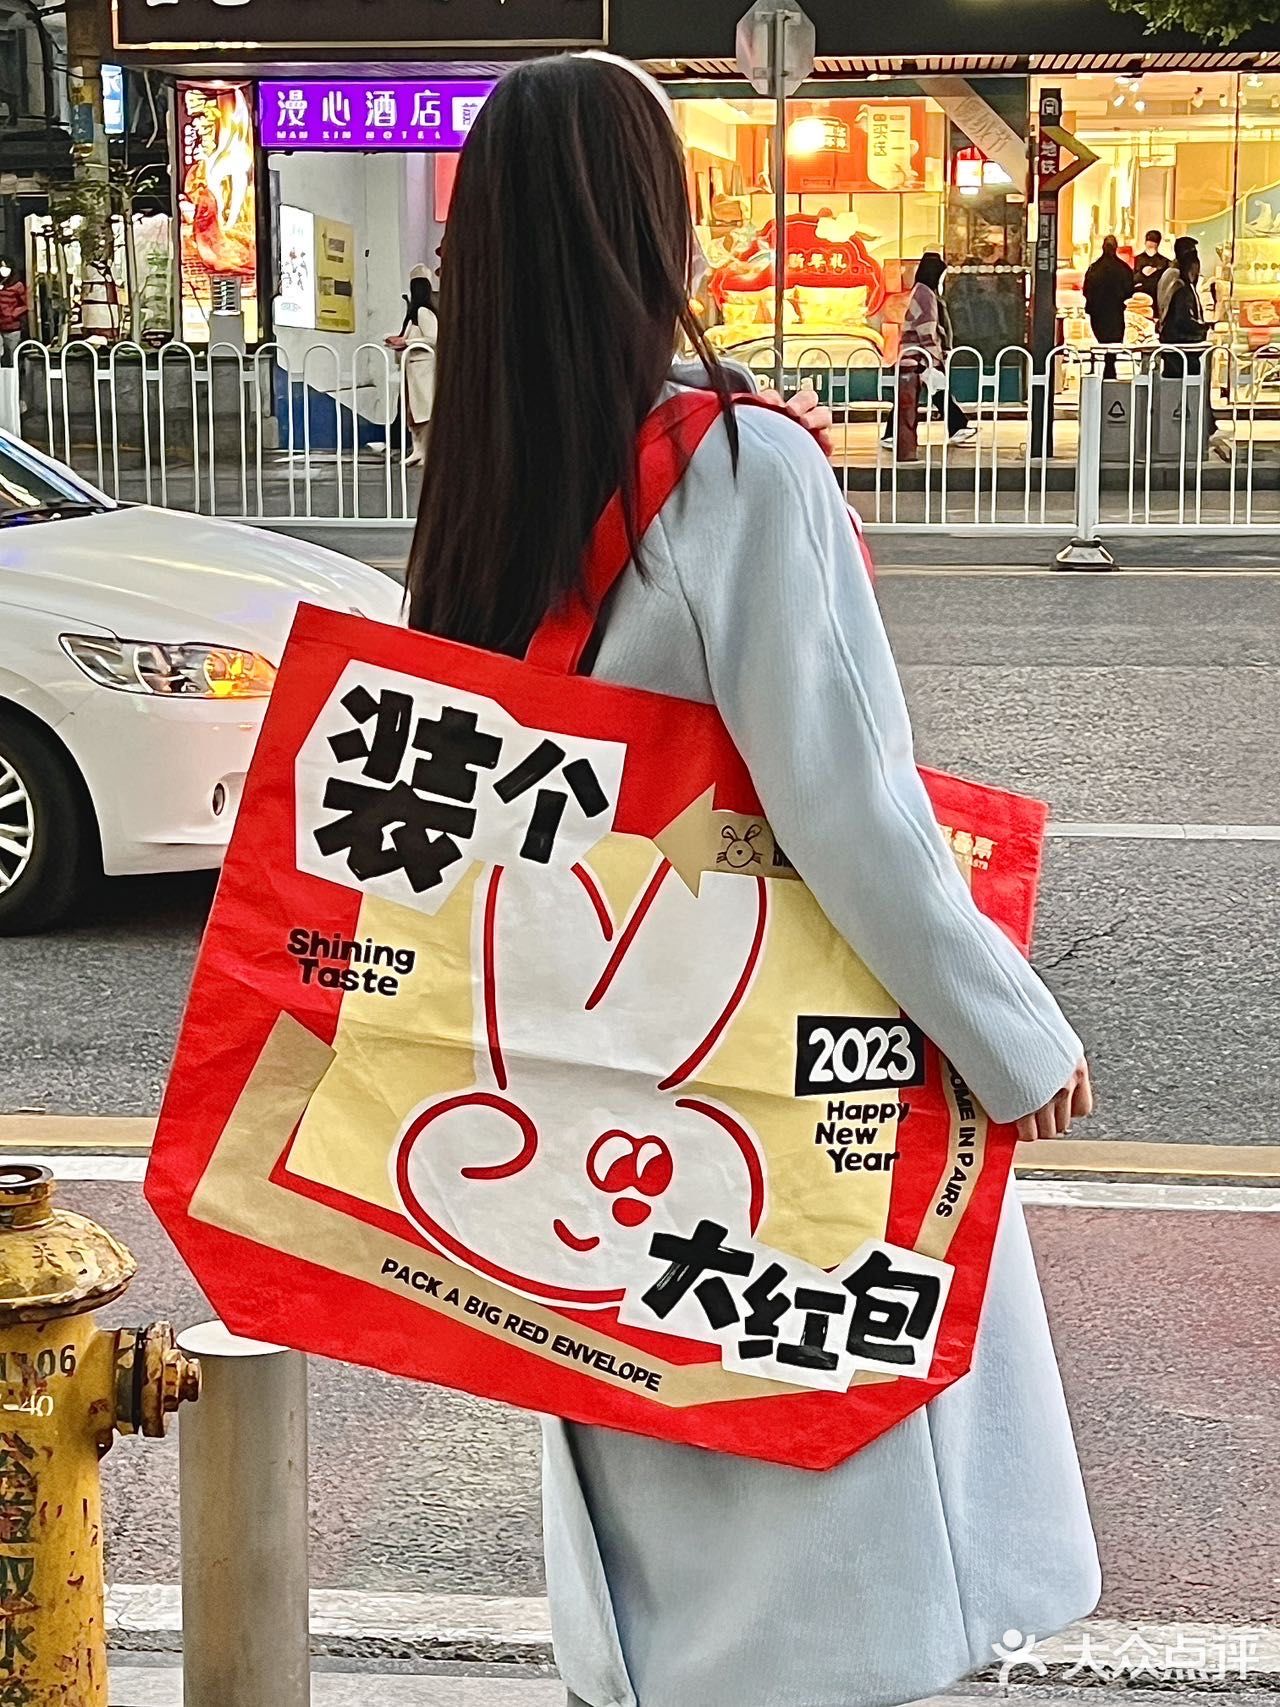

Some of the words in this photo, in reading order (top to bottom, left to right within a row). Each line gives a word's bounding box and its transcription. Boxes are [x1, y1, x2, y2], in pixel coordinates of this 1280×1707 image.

[277, 89, 441, 128] 漫心酒店
[313, 684, 609, 893] 装个
[287, 928, 415, 974] Shining
[298, 958, 398, 996] Taste
[808, 1025, 916, 1083] 2023
[827, 1100, 911, 1124] Happy
[815, 1121, 879, 1145] New
[958, 1126, 976, 1148] IN
[826, 1147, 902, 1174] Year
[641, 1219, 940, 1371] 大红包
[380, 1257, 444, 1298] PACK
[443, 1287, 461, 1307] A
[463, 1295, 501, 1326] BIG
[502, 1313, 549, 1345] RED
[550, 1334, 663, 1393] ENVELOPE
